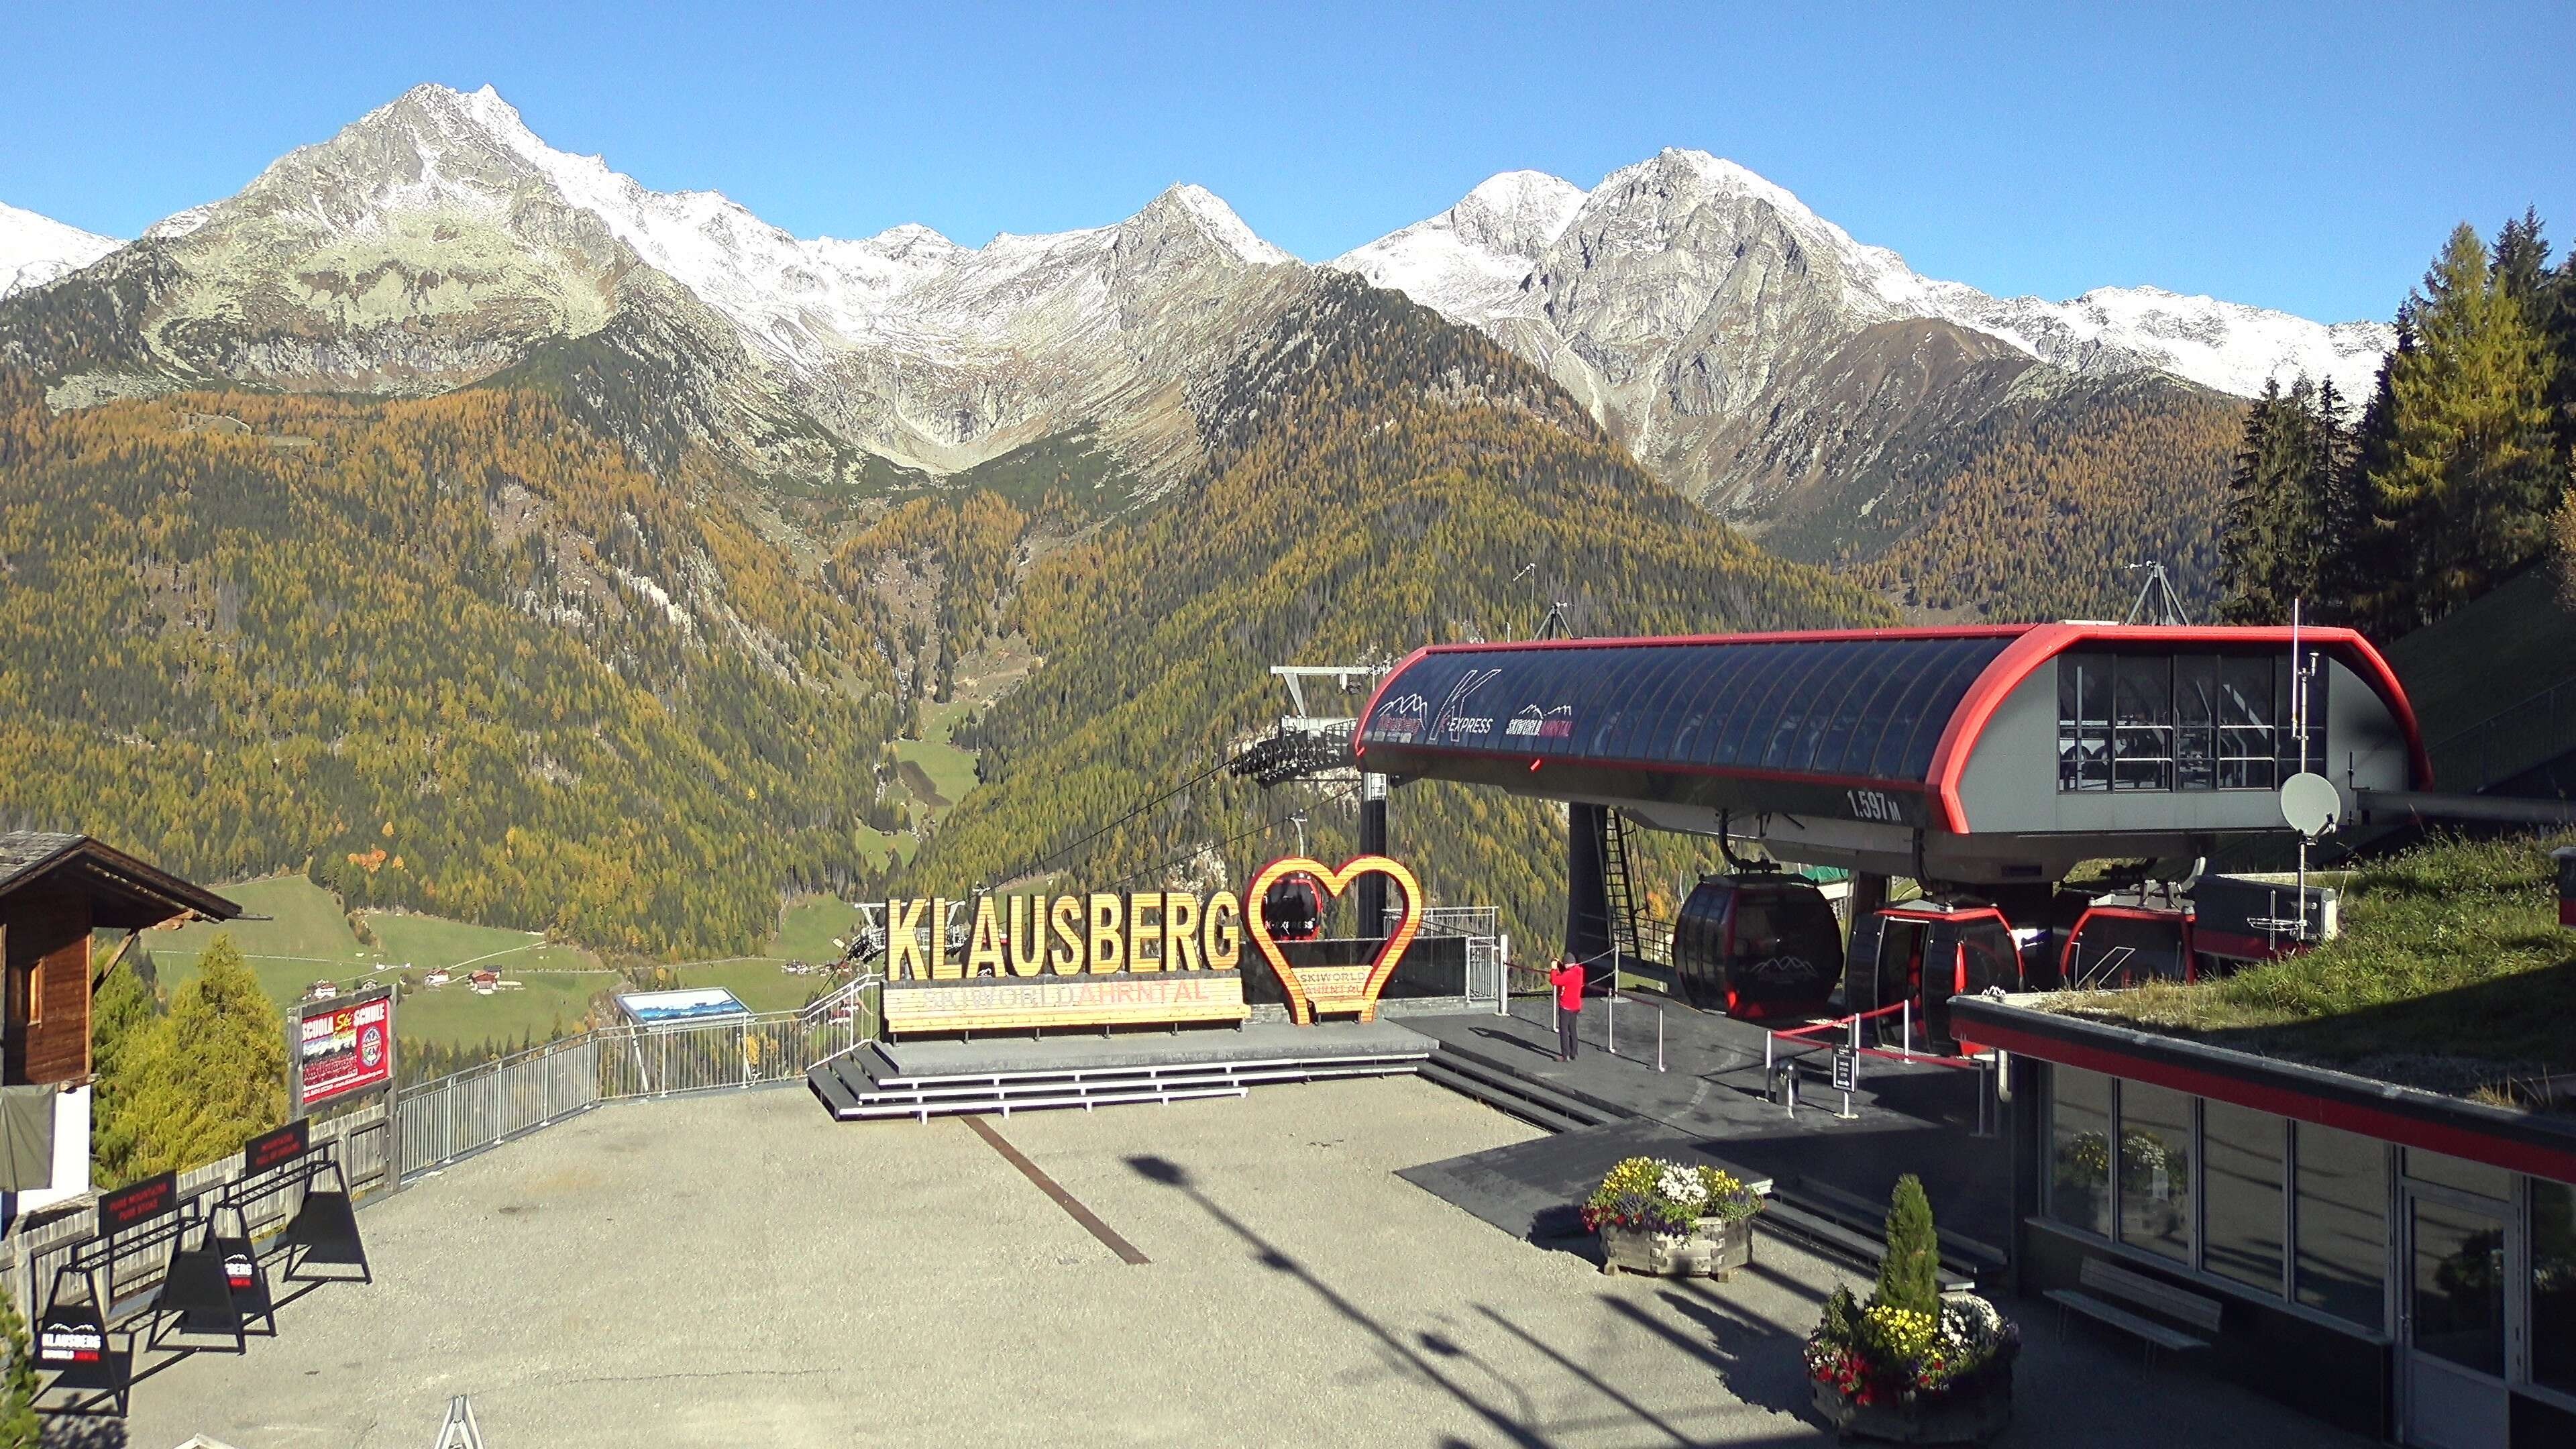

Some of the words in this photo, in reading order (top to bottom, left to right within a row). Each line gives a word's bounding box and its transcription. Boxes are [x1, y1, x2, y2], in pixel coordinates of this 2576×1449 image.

[1847, 790, 1888, 820] 1.597
[1888, 800, 1901, 820] M
[885, 891, 1240, 981] KLAUSBERG
[1300, 973, 1365, 983] SKIWORLD
[303, 1016, 333, 1040] SCUOLA
[354, 1003, 385, 1027] SCHULE
[42, 1334, 101, 1348] KLAUSBERG
